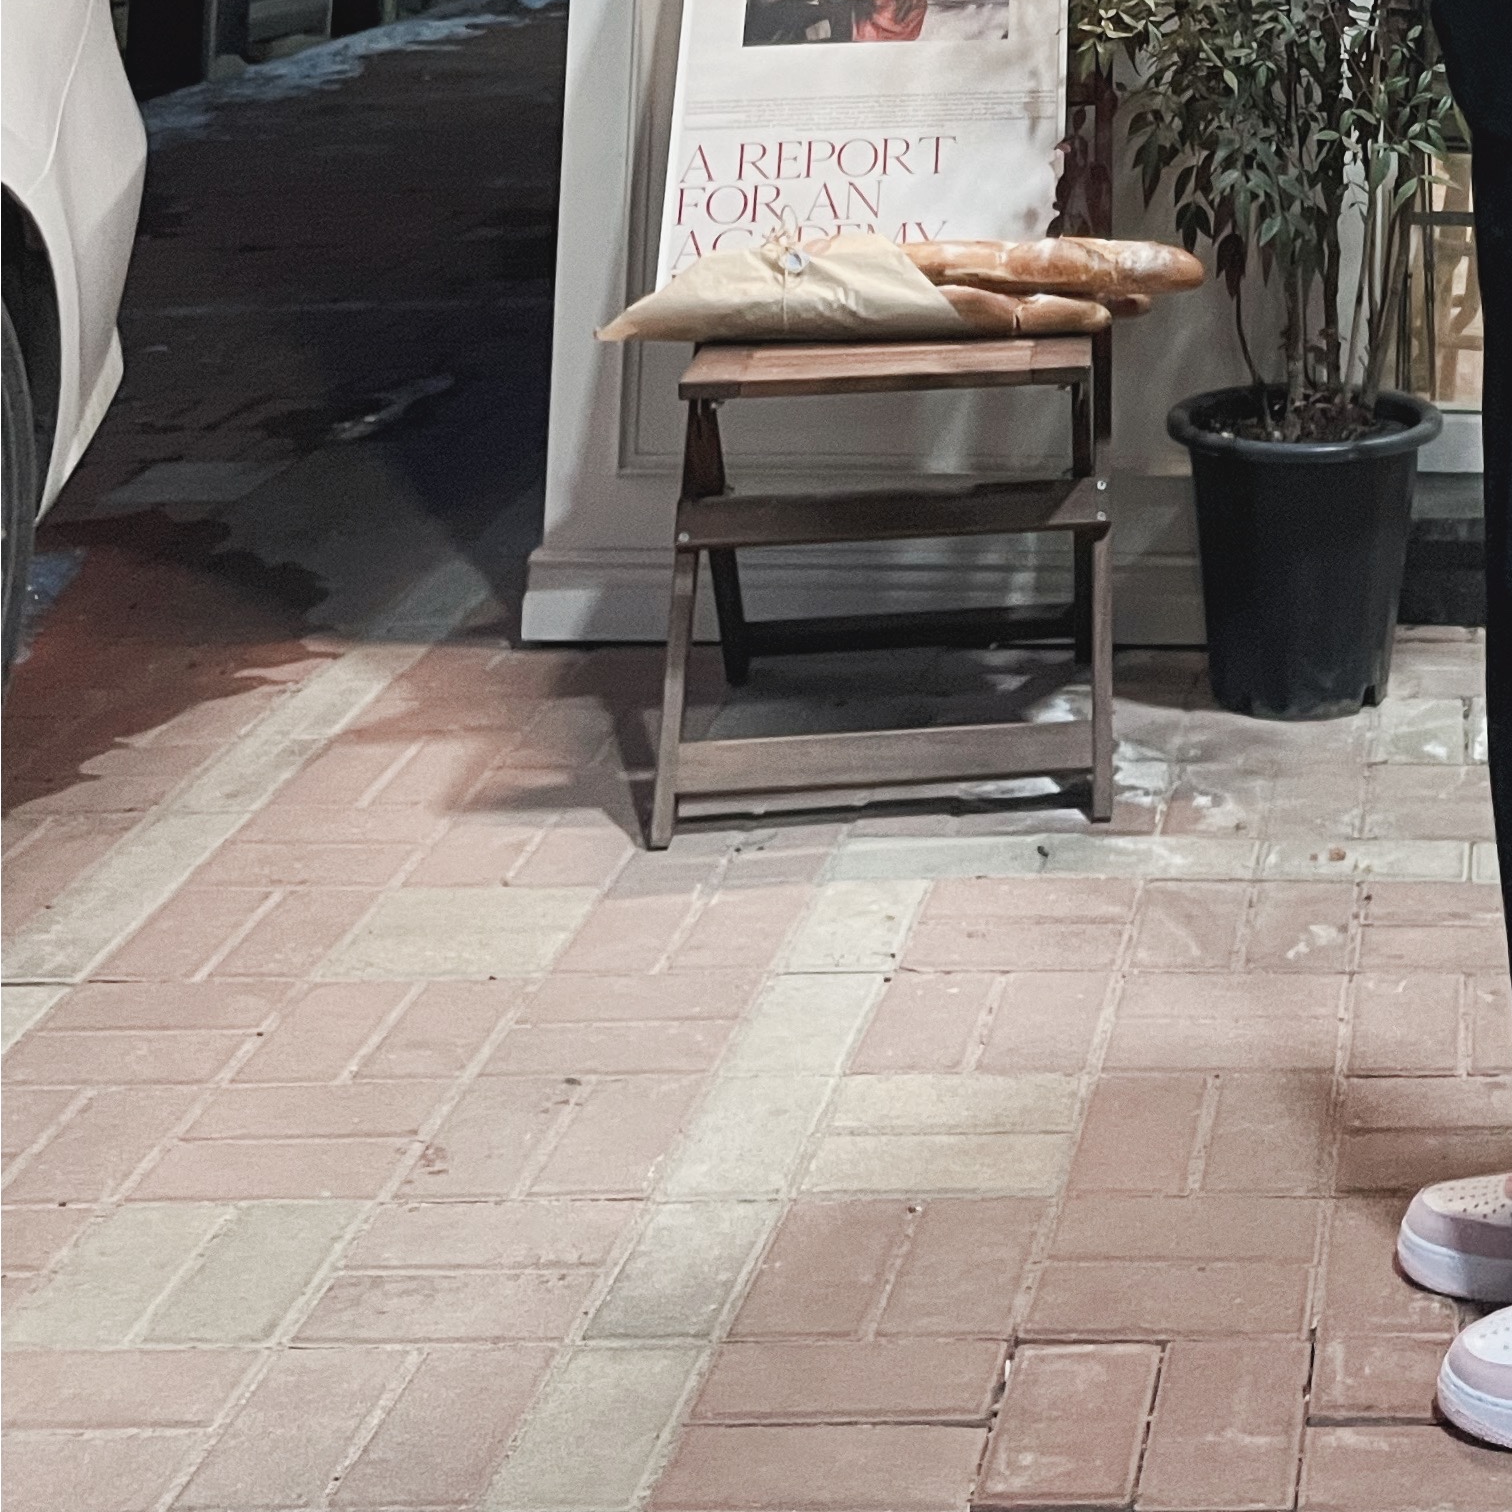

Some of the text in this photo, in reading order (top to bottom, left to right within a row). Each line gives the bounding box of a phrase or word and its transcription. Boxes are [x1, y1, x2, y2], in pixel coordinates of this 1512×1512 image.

[679, 135, 957, 183] A REPORT
[675, 180, 883, 226] FOR AN
